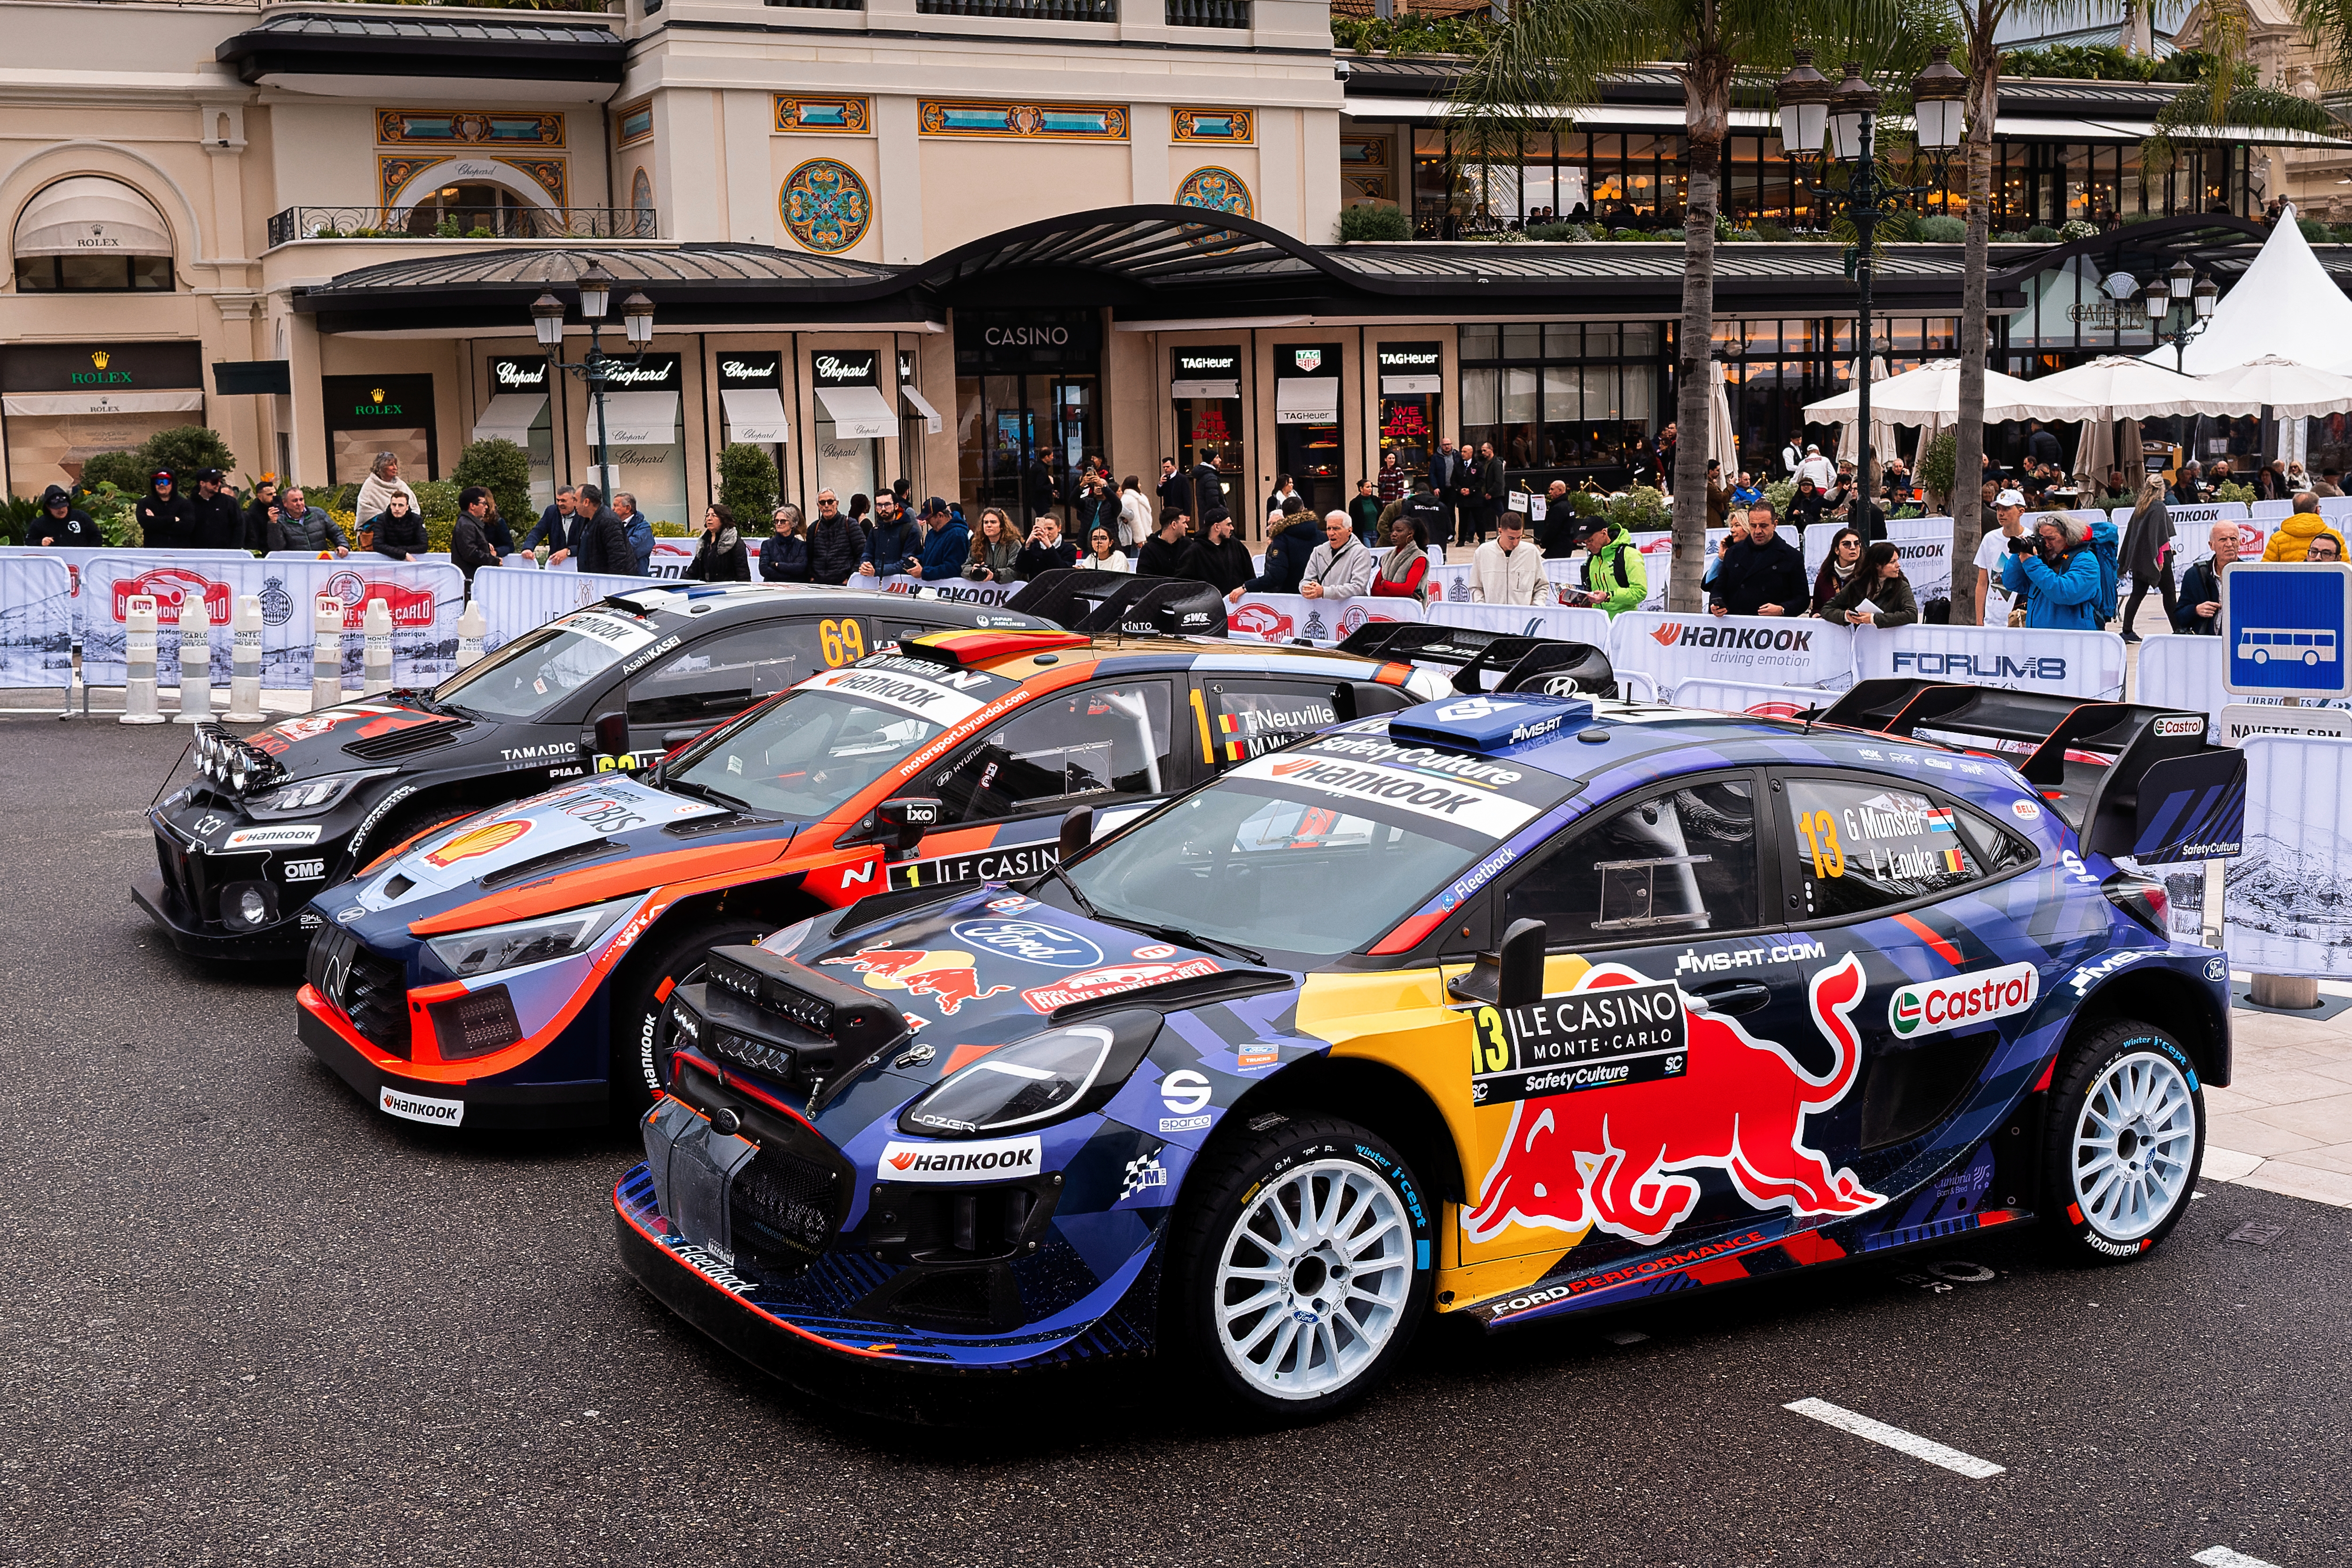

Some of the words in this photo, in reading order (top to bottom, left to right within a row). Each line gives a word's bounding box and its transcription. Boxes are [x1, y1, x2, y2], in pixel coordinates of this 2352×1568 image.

[455, 163, 497, 177] Chopard
[77, 238, 119, 247] ROLEX
[985, 326, 1069, 345] CASINO
[71, 372, 133, 384] ROLEX
[497, 362, 546, 387] Chopard
[723, 361, 775, 380] Chopard
[816, 356, 872, 382] Chopard
[355, 405, 403, 415] ROLEX
[1393, 406, 1419, 416] WE
[854, 424, 880, 435] Chopard
[1390, 416, 1423, 425] ARE
[612, 430, 649, 442] Chopard
[741, 428, 777, 439] Chopard
[1384, 425, 1428, 436] BACK
[615, 450, 669, 467] Chopard
[821, 443, 859, 459] Chopard
[2169, 509, 2219, 522] ANKOOK
[1898, 544, 1945, 559] NKOOK
[2238, 538, 2263, 552] ONTE-CARLO
[1183, 613, 1209, 623] SWS
[819, 618, 865, 668] 69
[622, 635, 682, 675] AsahiKASEI
[1711, 650, 1754, 667] driving
[1757, 653, 1810, 667] emotion
[880, 656, 949, 677] HYUNDAI
[1892, 652, 2067, 680] FORUM8
[2247, 696, 2312, 707] LUBRICTS
[1190, 688, 1214, 764] 1
[1239, 705, 1335, 732] T.Neuville
[1520, 715, 1563, 741] MS-RT
[2165, 719, 2201, 734] Castrol
[899, 689, 1030, 777] motorsport.hyundai.com
[501, 742, 576, 761] TAMADIC
[1309, 735, 1522, 786] SafetyCulture
[549, 766, 583, 778] PIAA
[589, 786, 646, 805] HYUNDAI
[548, 794, 647, 833] MOBIS
[906, 804, 933, 820] ixo
[2016, 804, 2036, 813] BELL
[347, 785, 410, 853] Panasonic
[352, 786, 418, 857] AUTOMOTIVE
[1843, 809, 1860, 841] G
[1860, 804, 1924, 840] Munster
[1798, 810, 1845, 879] 13
[2182, 841, 2240, 857] SafetyCulture
[284, 864, 324, 878] OMP
[977, 847, 1059, 880] CASIN
[1454, 846, 1518, 900] Fleetback
[1869, 849, 1887, 882] L
[1889, 846, 1937, 880] Louka
[906, 865, 920, 887] 1
[602, 918, 639, 961] HYUNDAI
[963, 923, 1083, 959] Ford
[1176, 961, 1205, 973] 2025
[1691, 942, 1827, 973] MS-RT.COM
[2209, 959, 2225, 978] Ford
[1030, 989, 1069, 998] 2025
[1038, 990, 1096, 1009] RALLYE
[1925, 970, 2031, 1025] Castrol
[1516, 1006, 1552, 1038] LE
[1556, 992, 1677, 1033] CASINO
[1463, 1005, 1510, 1074] 13
[2123, 1036, 2151, 1048] Winter
[1664, 1056, 1684, 1072] SC
[1525, 1065, 1629, 1093] SafetyCulture
[910, 1111, 976, 1132] LAZER
[1161, 1116, 1209, 1131] sparco
[1355, 1144, 1391, 1168] Winter
[1934, 1171, 1971, 1189] Cumbria
[1937, 1189, 1950, 1197] Born
[1955, 1185, 1968, 1194] Bred
[671, 1244, 758, 1295] Fleetback
[1298, 1312, 1315, 1323] Ford
